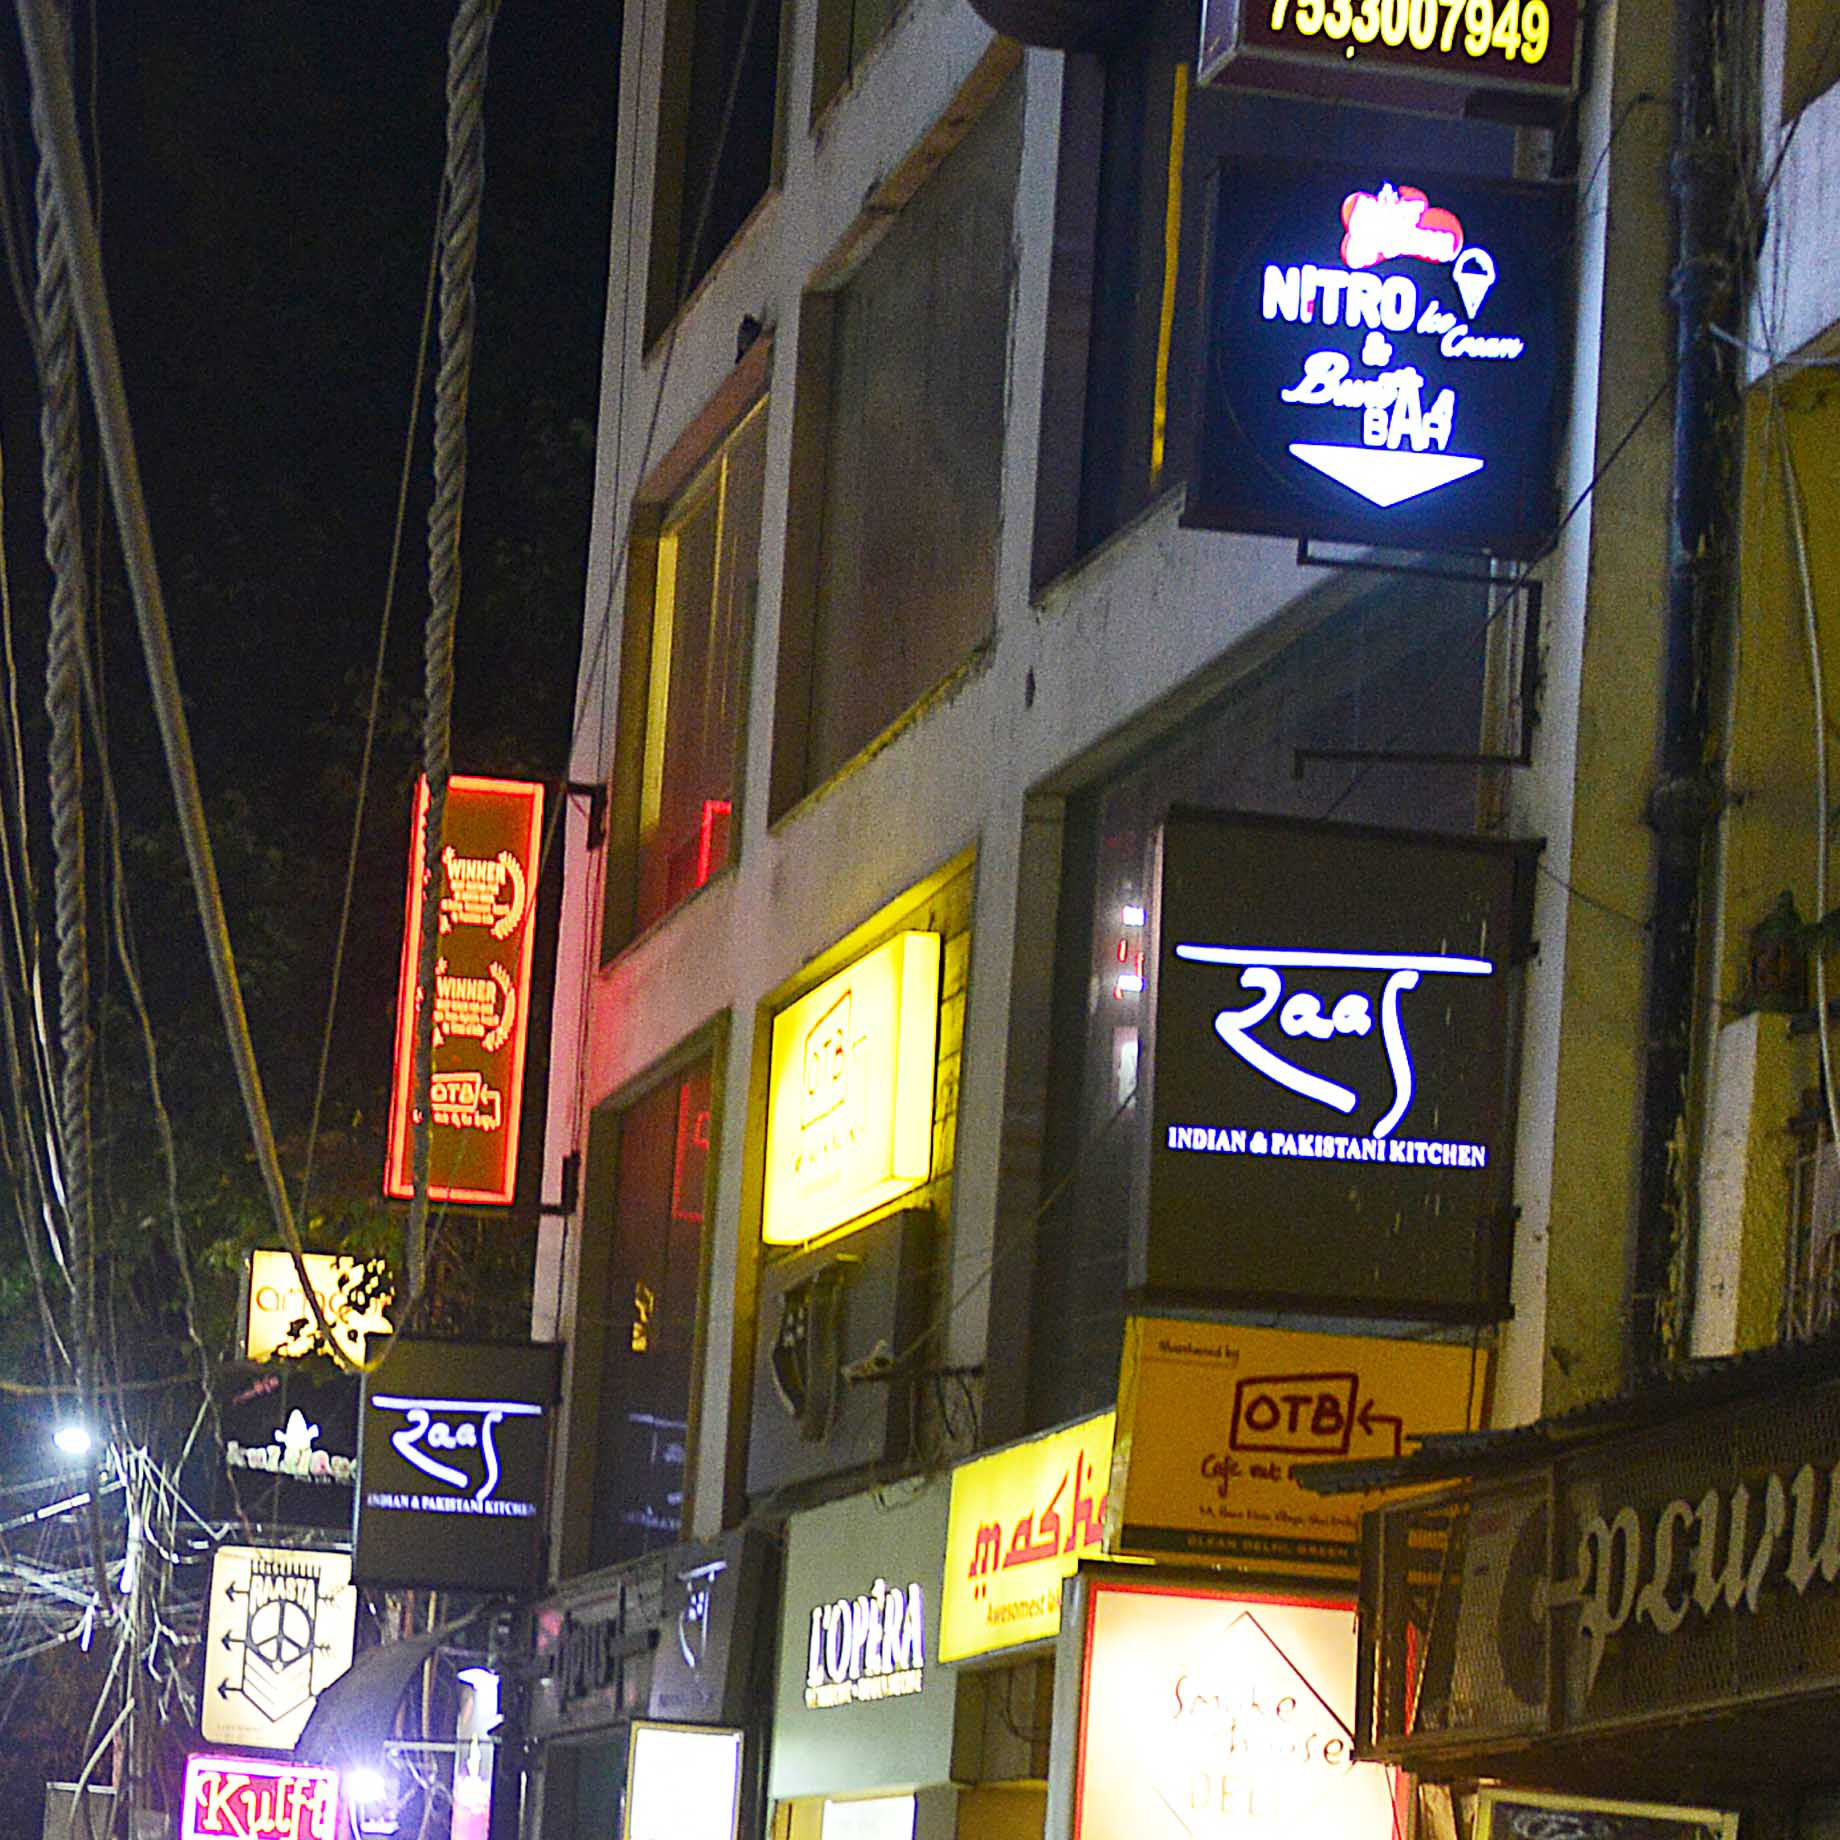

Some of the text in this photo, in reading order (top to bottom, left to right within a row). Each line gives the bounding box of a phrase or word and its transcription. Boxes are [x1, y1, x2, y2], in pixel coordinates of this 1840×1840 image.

[1263, 265, 1417, 331] NITRO
[437, 976, 497, 1003] WINNER
[1168, 1126, 1486, 1168] INDIAN & PAKISTANI KITCHEN
[1245, 1393, 1345, 1435] OTB
[1173, 1675, 1296, 1720] Smke
[1231, 1718, 1344, 1764] hse
